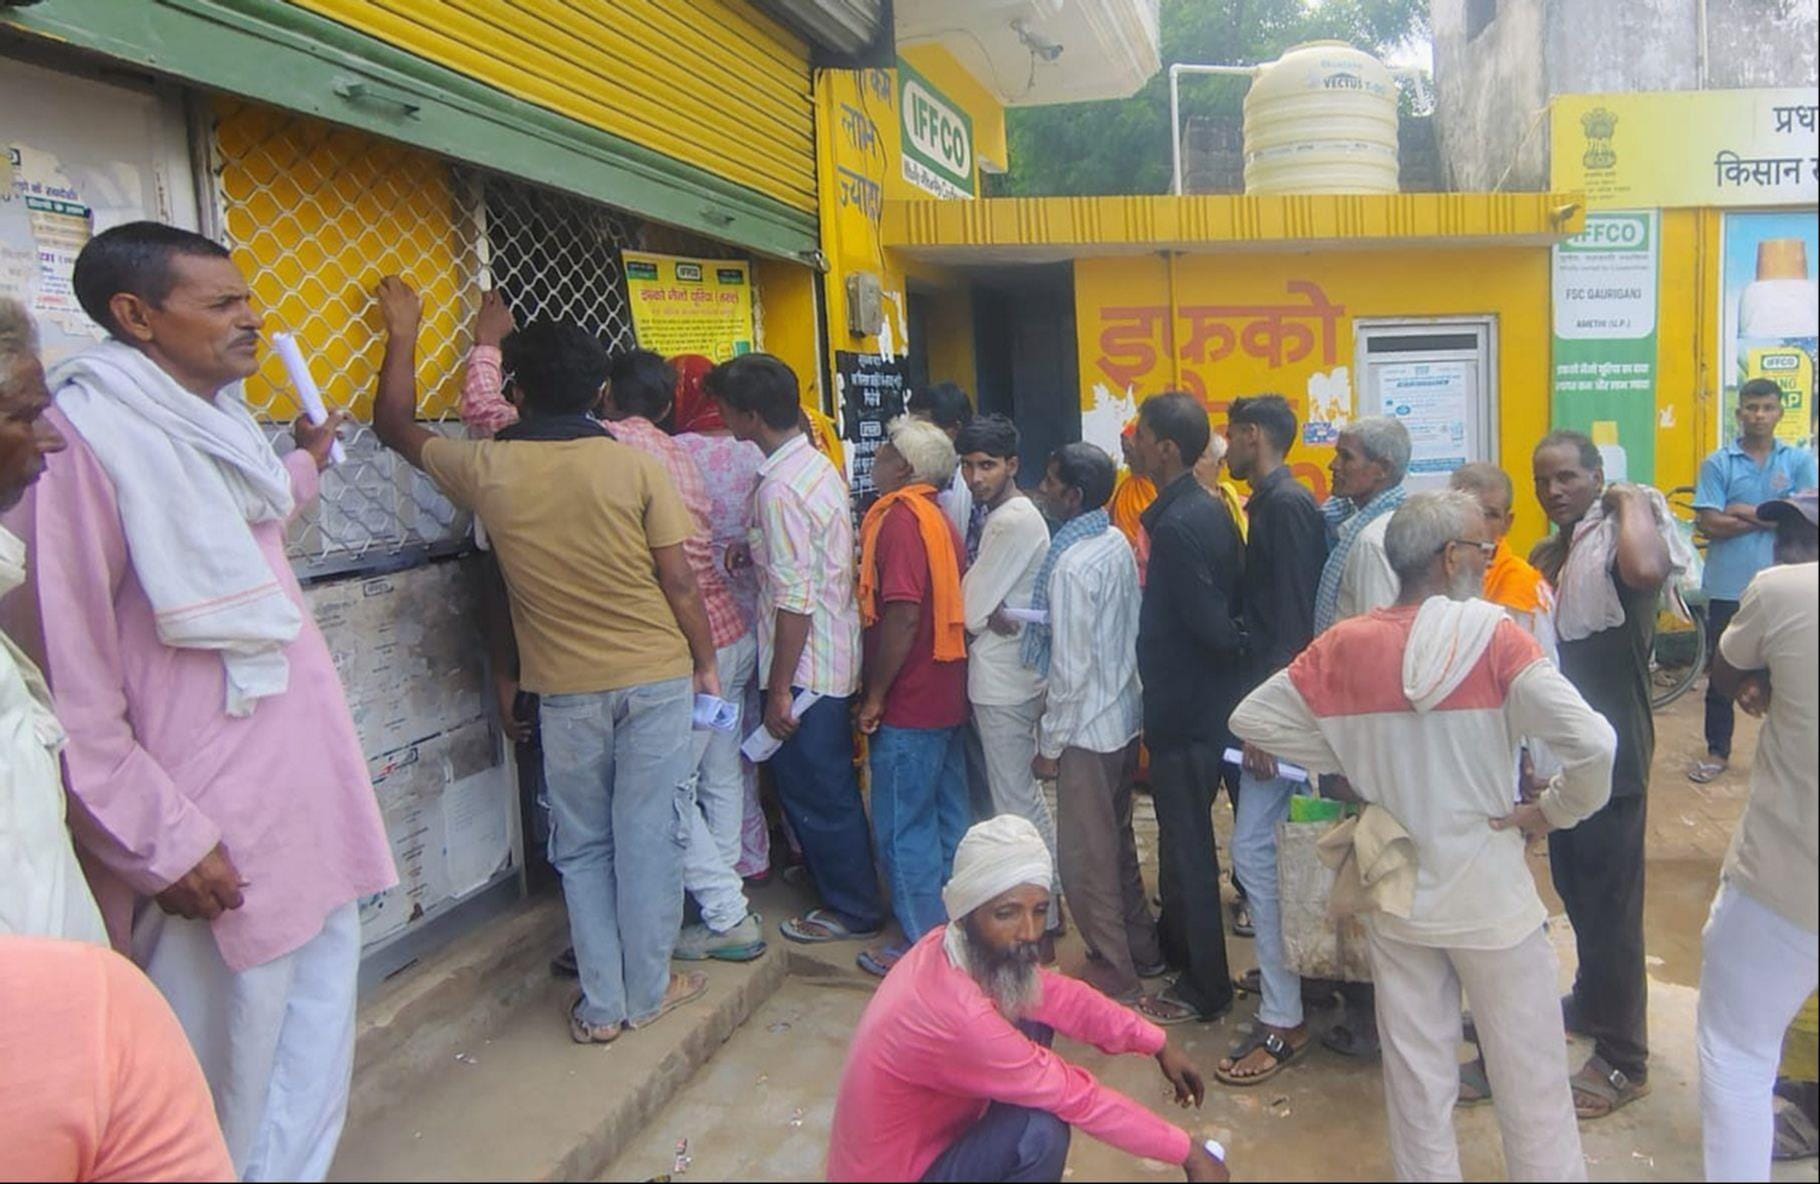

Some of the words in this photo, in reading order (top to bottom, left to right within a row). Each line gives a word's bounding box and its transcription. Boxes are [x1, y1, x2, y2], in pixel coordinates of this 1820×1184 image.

[1324, 78, 1363, 89] VECTUS
[911, 92, 965, 169] IFFCO
[1714, 150, 1803, 187] किसान
[1566, 288, 1585, 300] FSC
[1096, 280, 1346, 393] इफको
[1766, 357, 1796, 366] IFFCO
